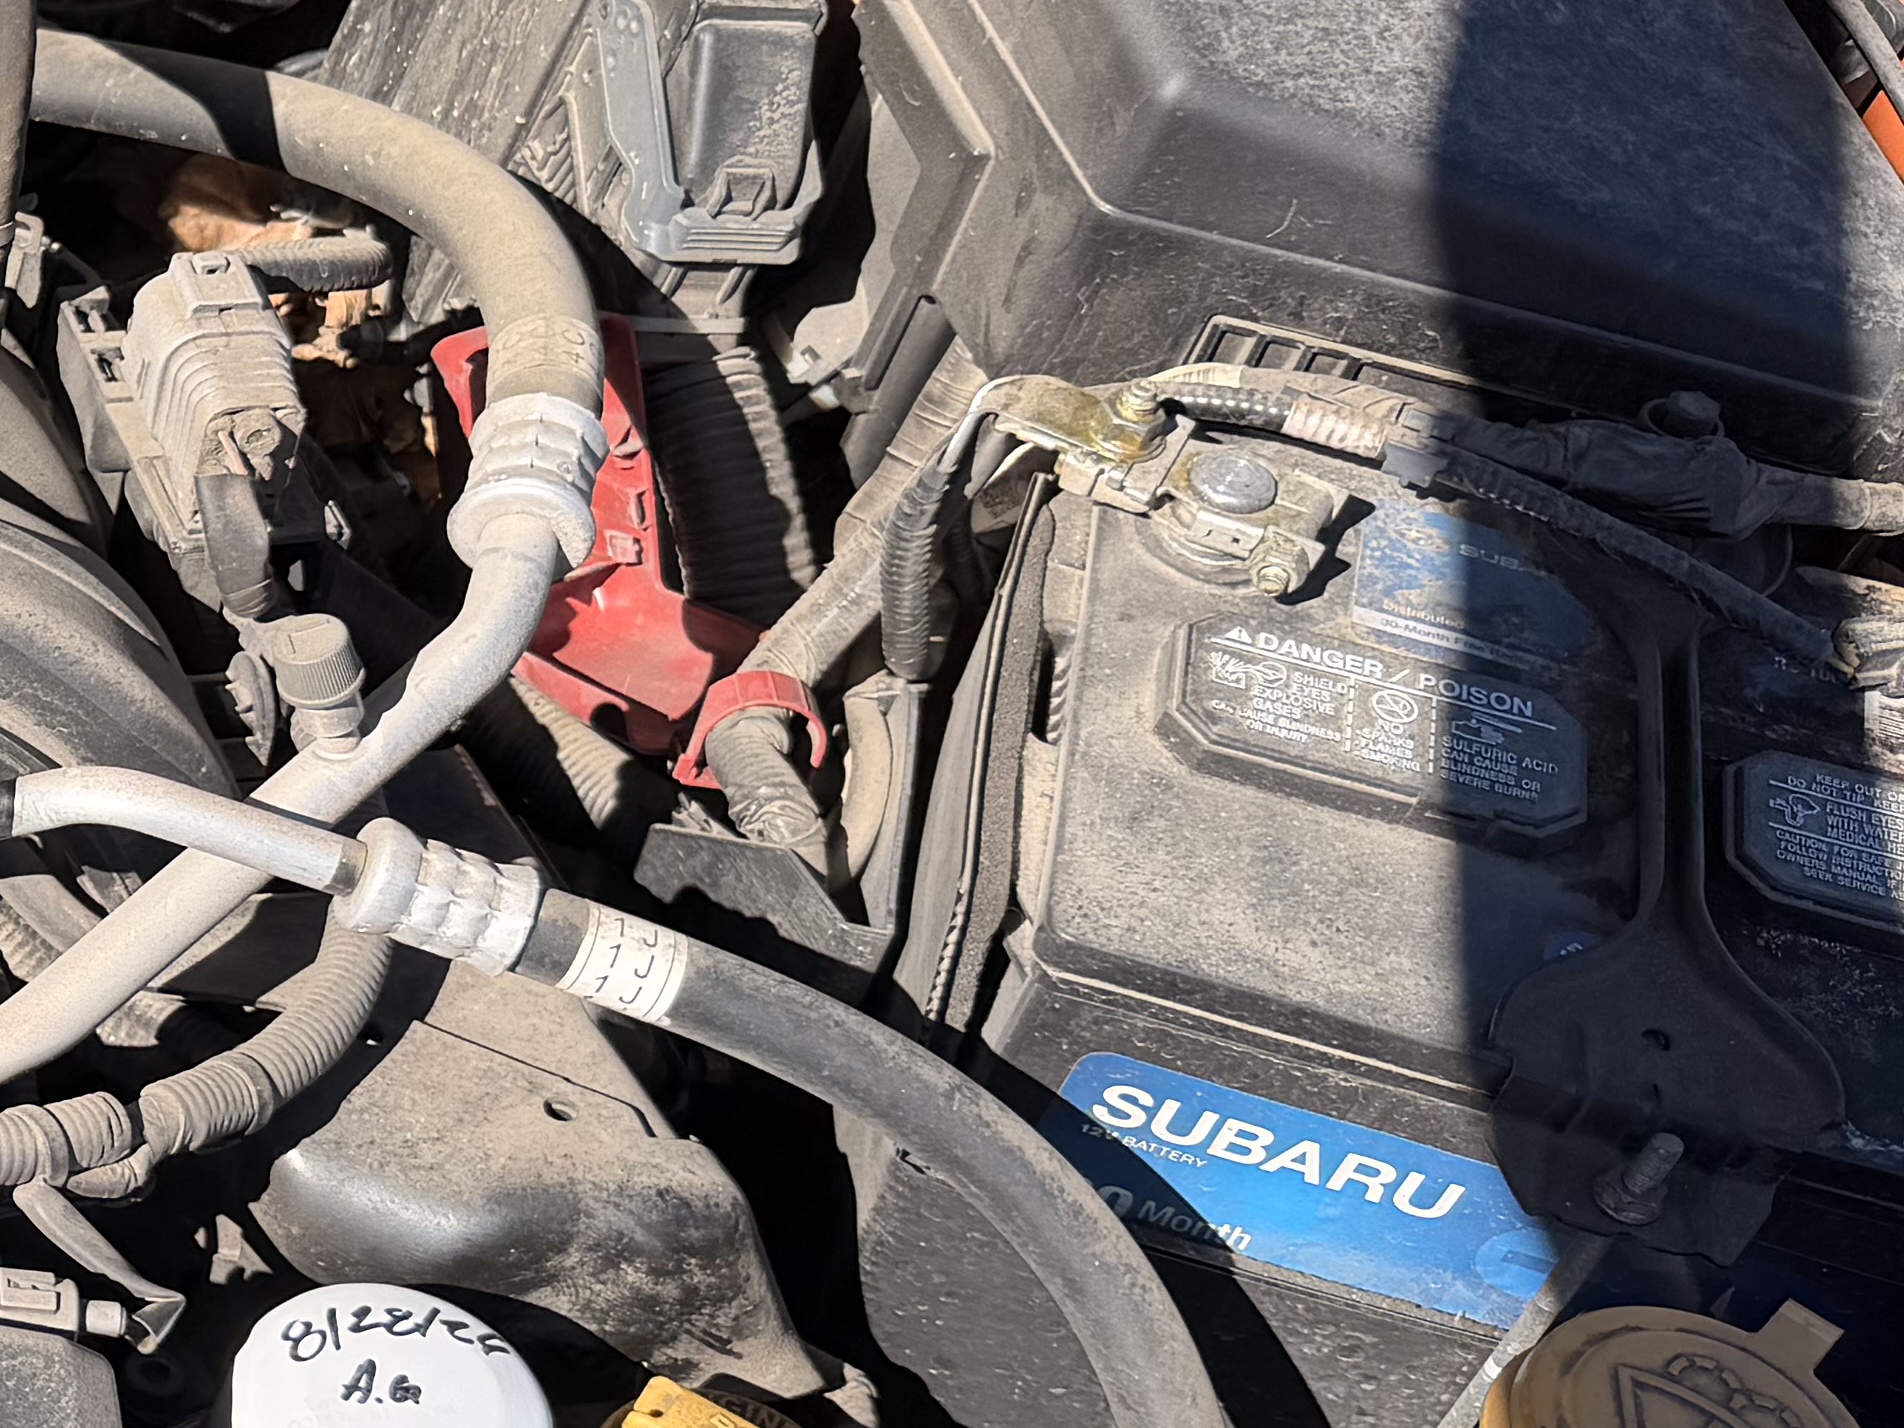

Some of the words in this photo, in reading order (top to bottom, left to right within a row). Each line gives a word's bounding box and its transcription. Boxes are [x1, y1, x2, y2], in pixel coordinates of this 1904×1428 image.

[1256, 631, 1384, 680] DANGER
[1418, 672, 1533, 717] POISON
[1293, 671, 1348, 695] SHIELD
[1252, 686, 1336, 716] EXPLOSIVE
[1291, 684, 1331, 702] EYES
[1252, 698, 1302, 719] GASES
[1376, 720, 1404, 735] NO
[1441, 735, 1518, 765] SULFURIC
[1522, 757, 1559, 774] ACID
[1441, 748, 1472, 763] CAN
[1787, 775, 1806, 788] DO
[1812, 783, 1837, 796] NOT
[1816, 773, 1849, 789] KEEP
[1855, 783, 1882, 798] OUT
[1826, 802, 1866, 822] FLUSH
[1871, 813, 1904, 830] EYES
[1827, 815, 1859, 832] WITH
[1827, 827, 1883, 850] MEDICAL
[1080, 1122, 1118, 1142] 12V
[1120, 1134, 1208, 1168] BATTERY
[1091, 1084, 1467, 1219] SUBARU
[1137, 1199, 1253, 1253] Month
